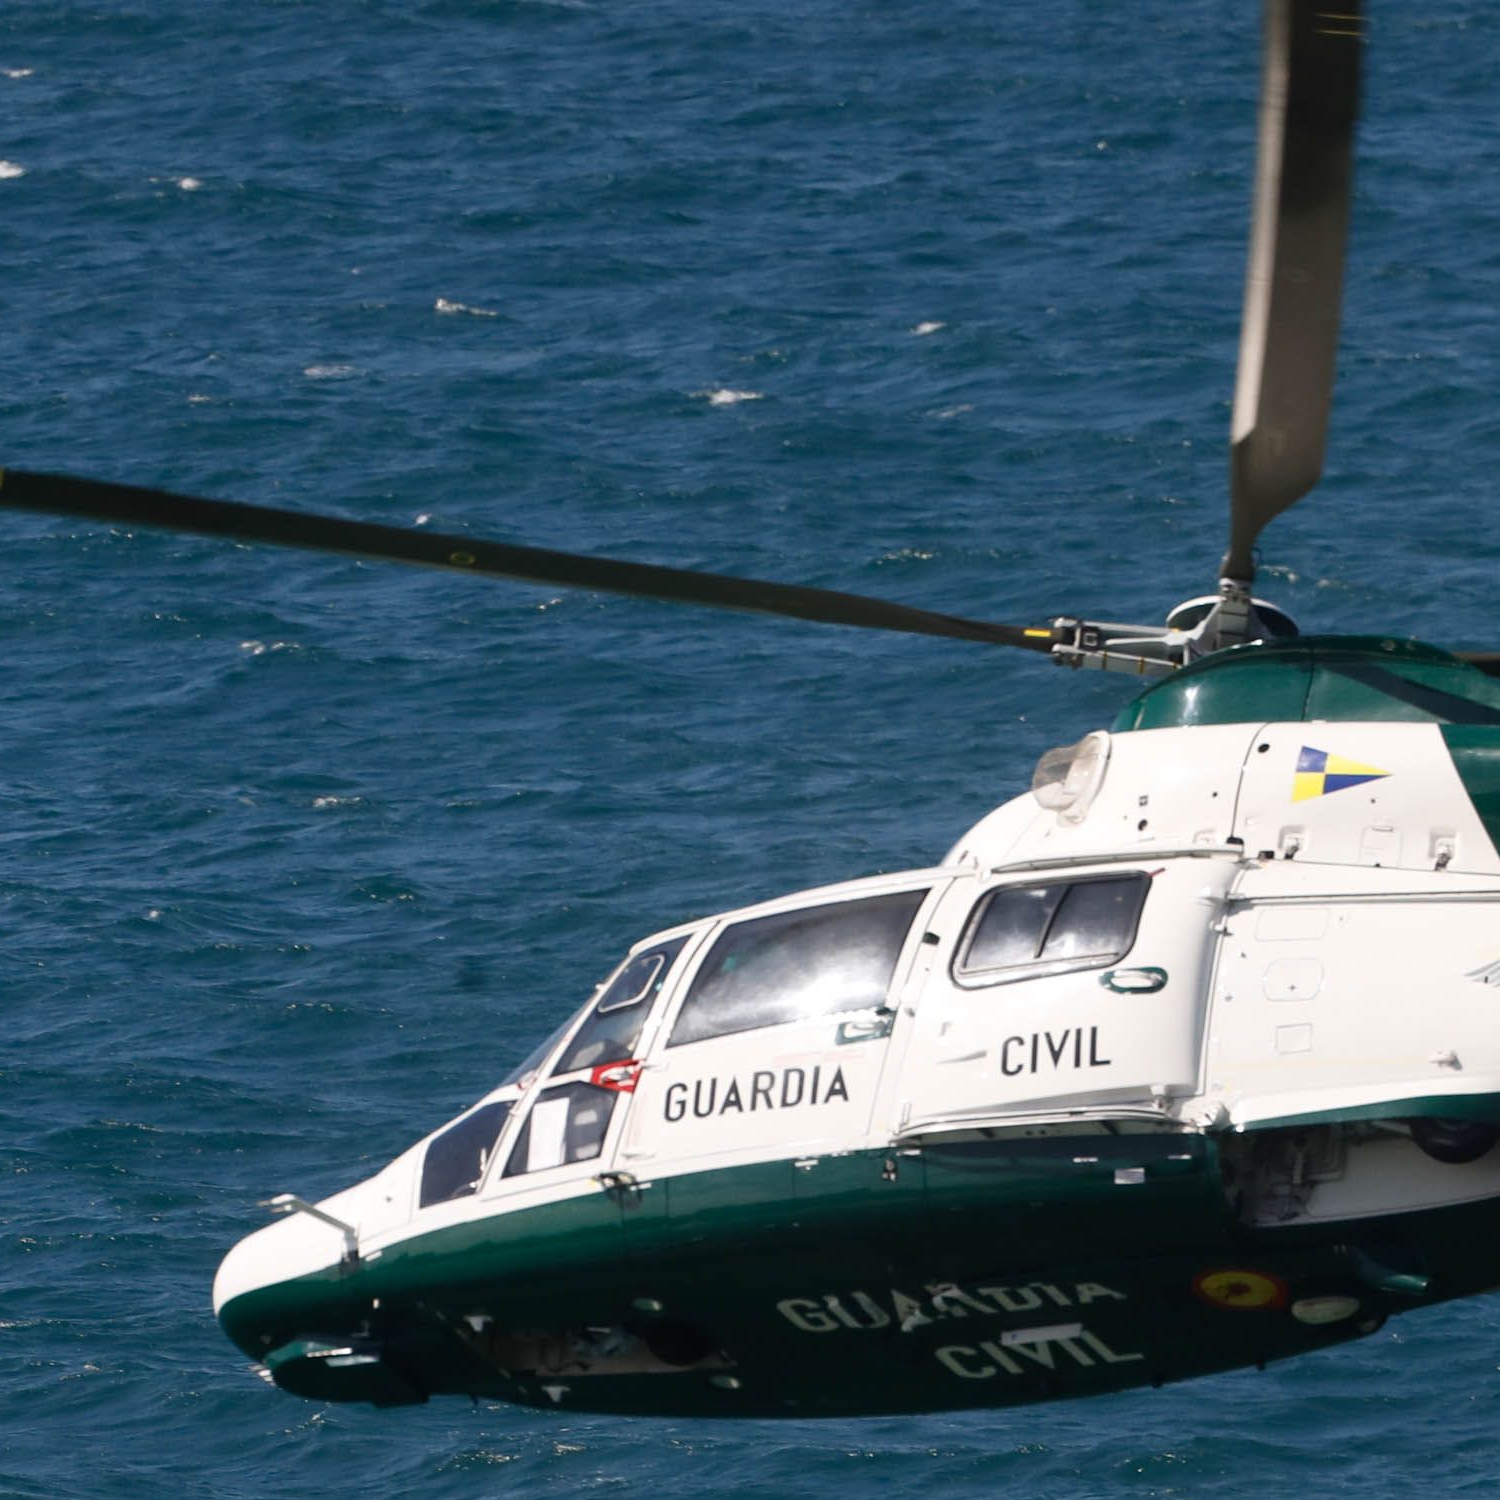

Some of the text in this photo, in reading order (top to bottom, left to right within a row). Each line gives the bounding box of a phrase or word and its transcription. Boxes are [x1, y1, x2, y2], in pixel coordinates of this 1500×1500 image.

[663, 1025, 1112, 1123] GUARDIA CIVIL
[934, 1329, 1145, 1380] CIVIL
